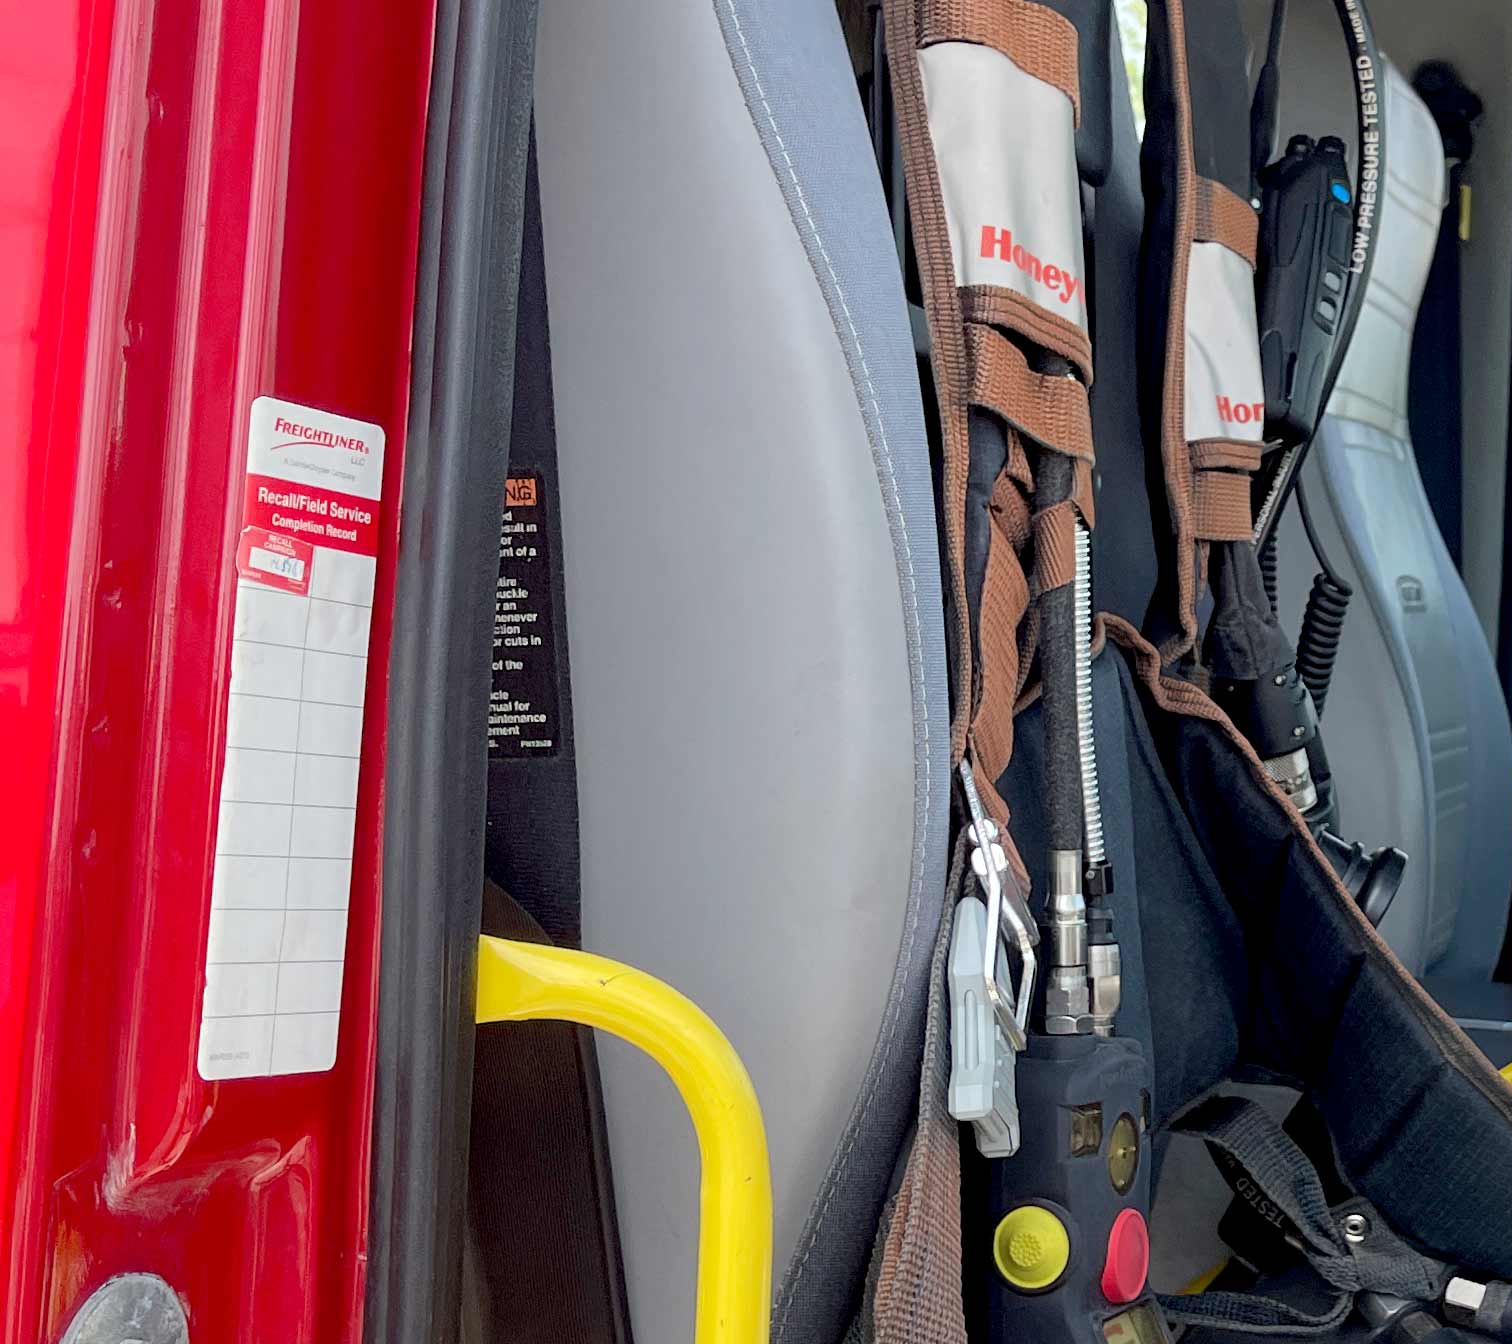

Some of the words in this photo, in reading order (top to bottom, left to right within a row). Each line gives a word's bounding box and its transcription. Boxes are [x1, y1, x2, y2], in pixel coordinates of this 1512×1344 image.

[1349, 9, 1367, 44] MADE
[1355, 56, 1379, 127] TESTED
[1357, 130, 1379, 227] PRESSURE
[1350, 231, 1370, 274] LOW
[274, 417, 365, 454] FREIGHTLINER
[258, 487, 328, 516] Recall/Field
[330, 502, 372, 525] Service
[272, 514, 325, 536] Completion
[326, 524, 358, 542] Record
[504, 636, 529, 646] cuts
[530, 634, 542, 646] in
[504, 660, 524, 671] the
[513, 701, 531, 711] for
